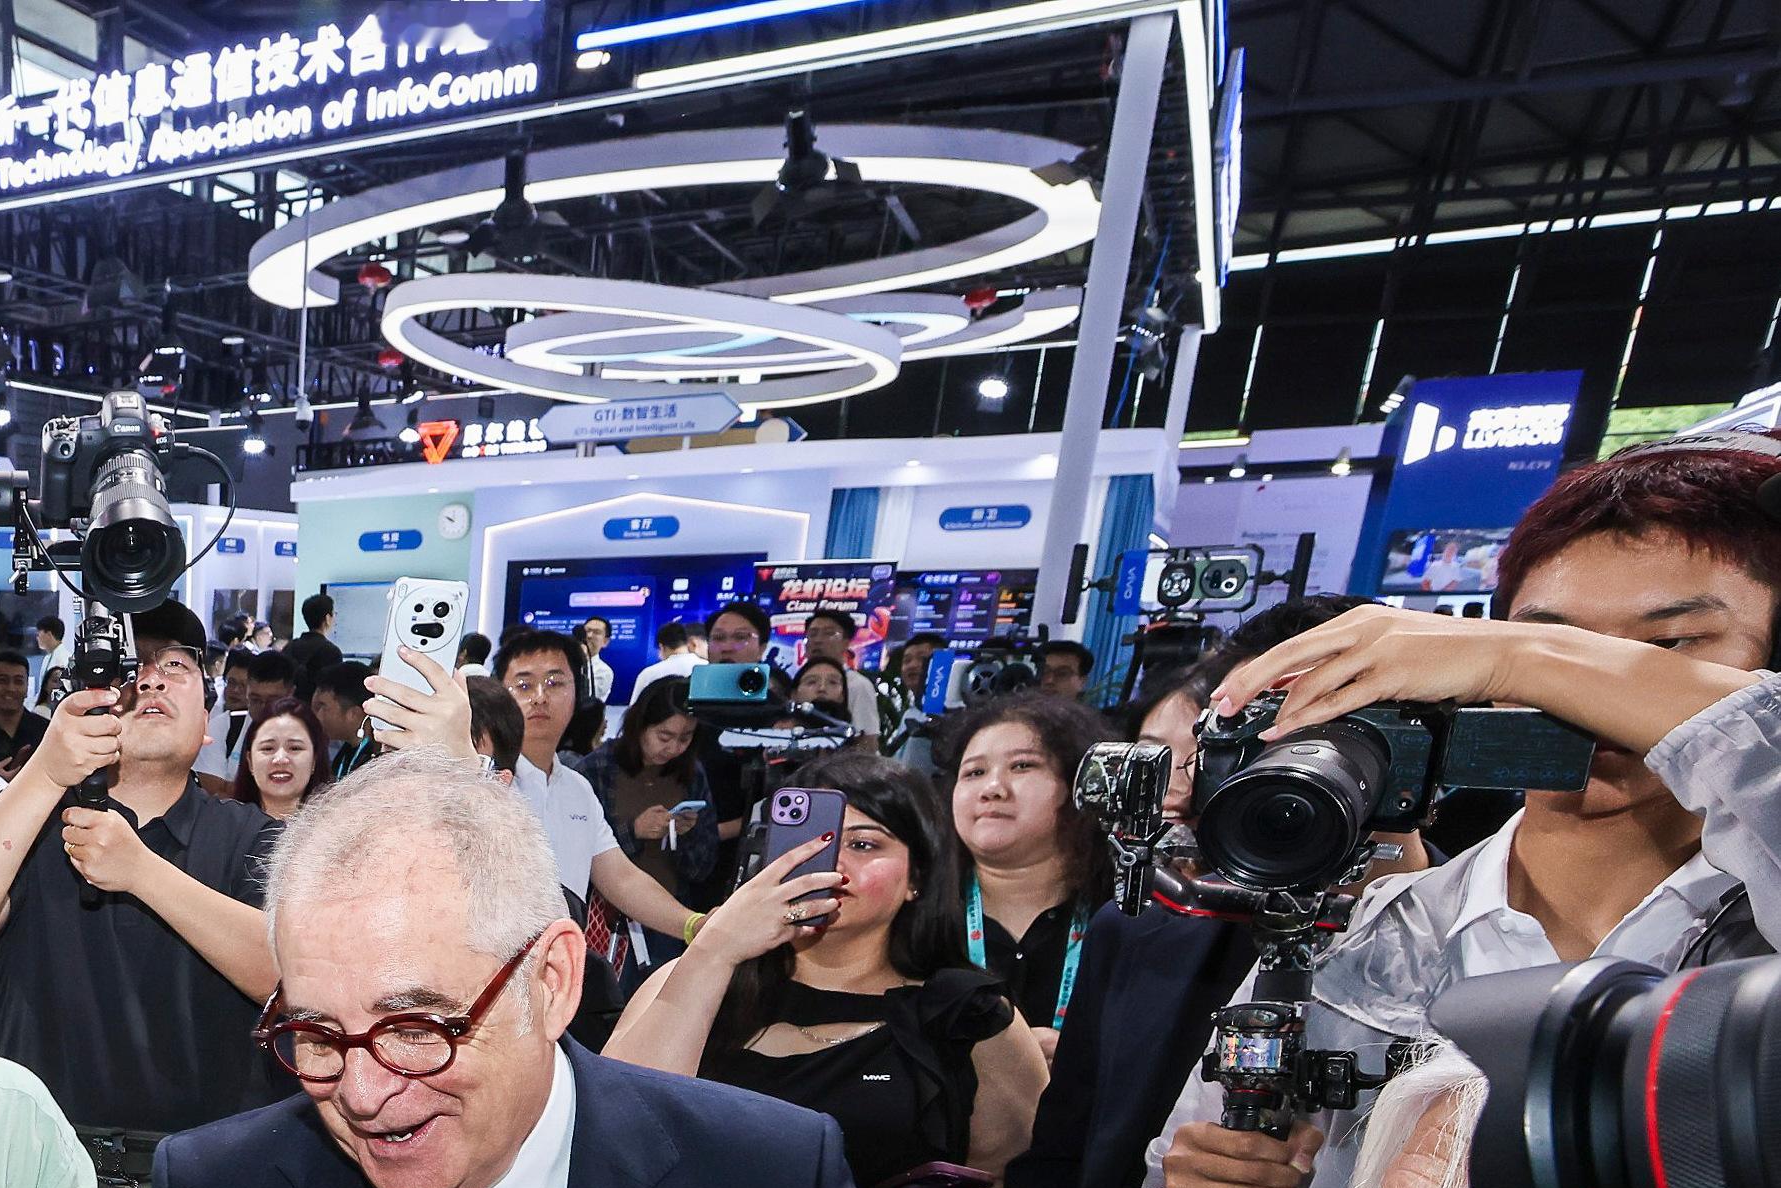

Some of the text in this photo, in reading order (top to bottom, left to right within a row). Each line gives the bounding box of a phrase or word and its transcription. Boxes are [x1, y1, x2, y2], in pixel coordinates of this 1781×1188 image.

[148, 104, 312, 163] Association
[322, 88, 358, 130] of
[366, 62, 538, 122] InfoComm
[114, 423, 141, 433] Canon
[1122, 564, 1137, 600] vivo
[785, 600, 818, 612] Claw
[930, 665, 945, 699] vivo
[569, 813, 588, 822] vivo
